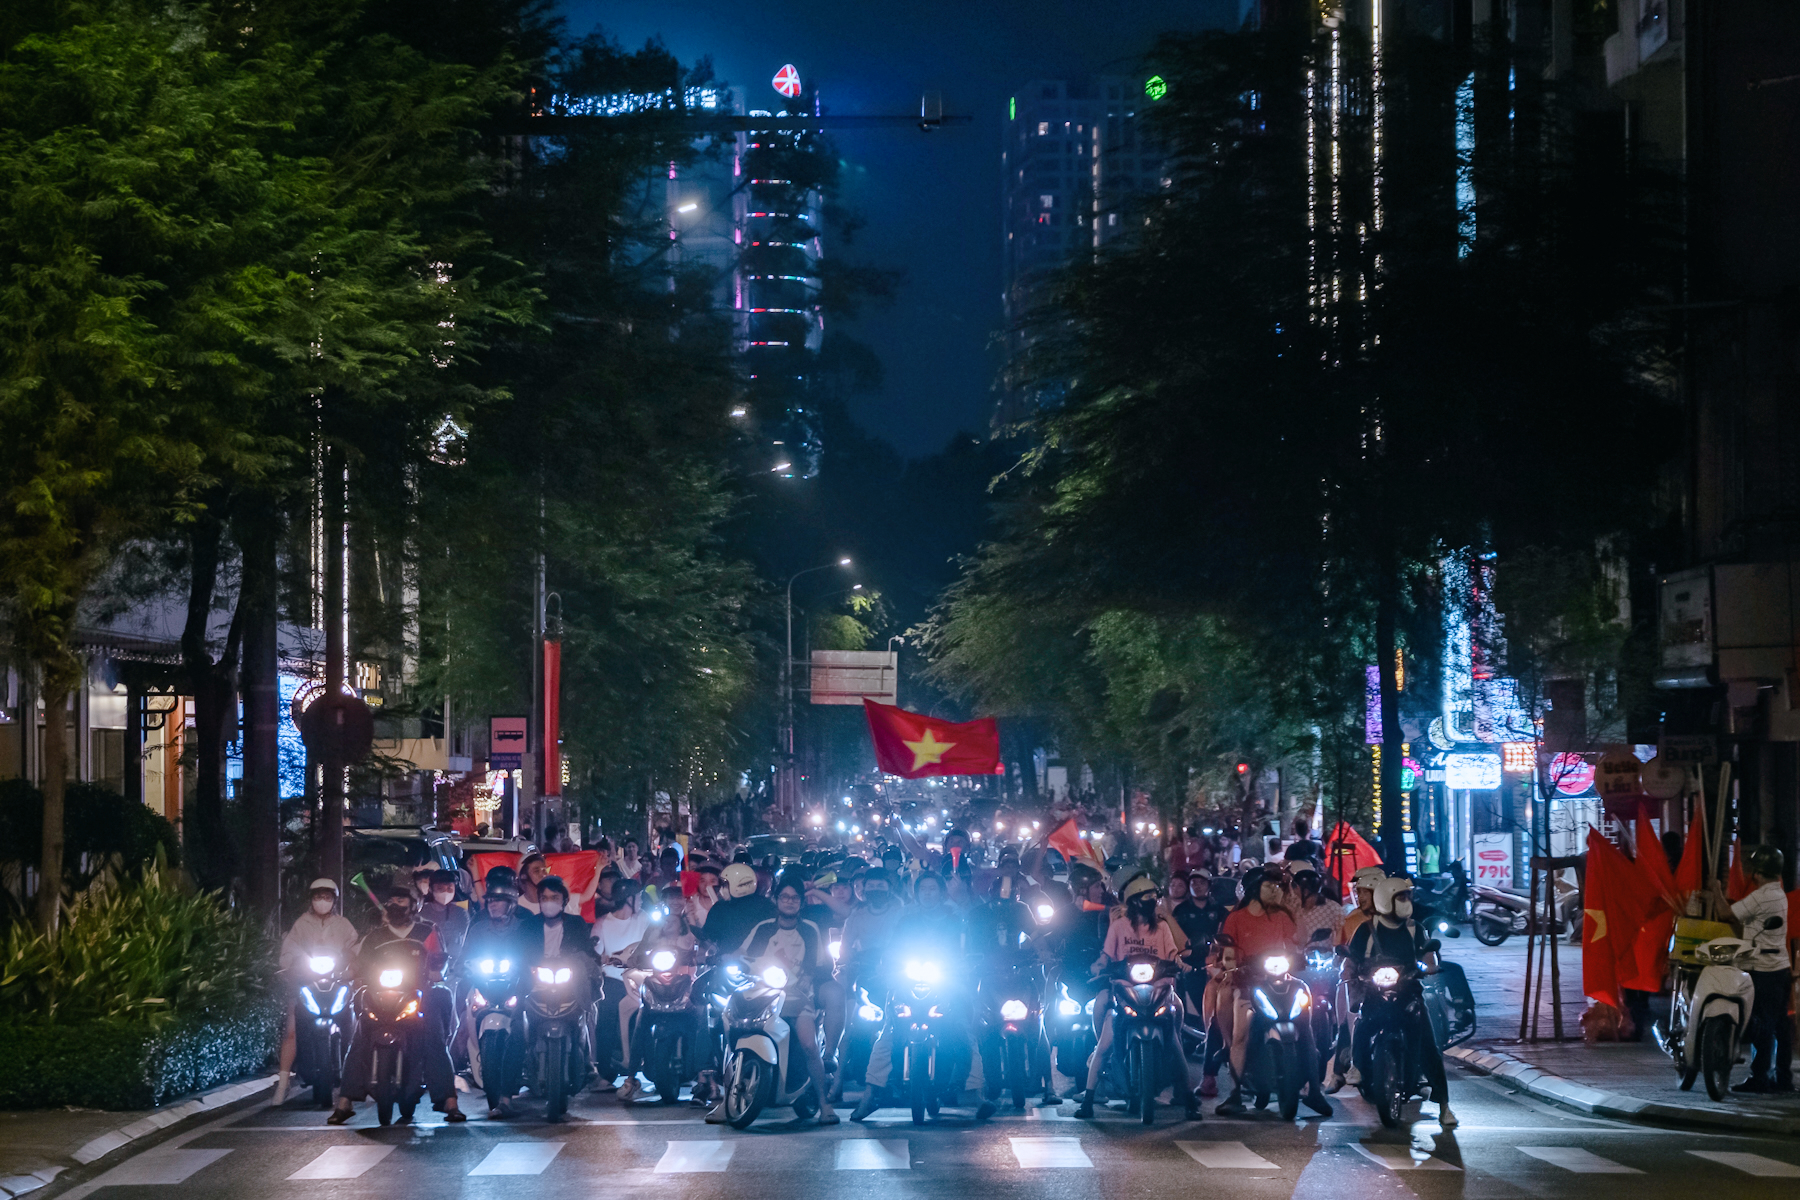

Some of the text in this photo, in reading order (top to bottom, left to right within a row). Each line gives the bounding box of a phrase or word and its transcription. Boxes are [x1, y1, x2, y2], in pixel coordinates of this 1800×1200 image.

[1478, 865, 1511, 878] 79K
[1124, 937, 1145, 945] kind
[1130, 946, 1158, 955] people
